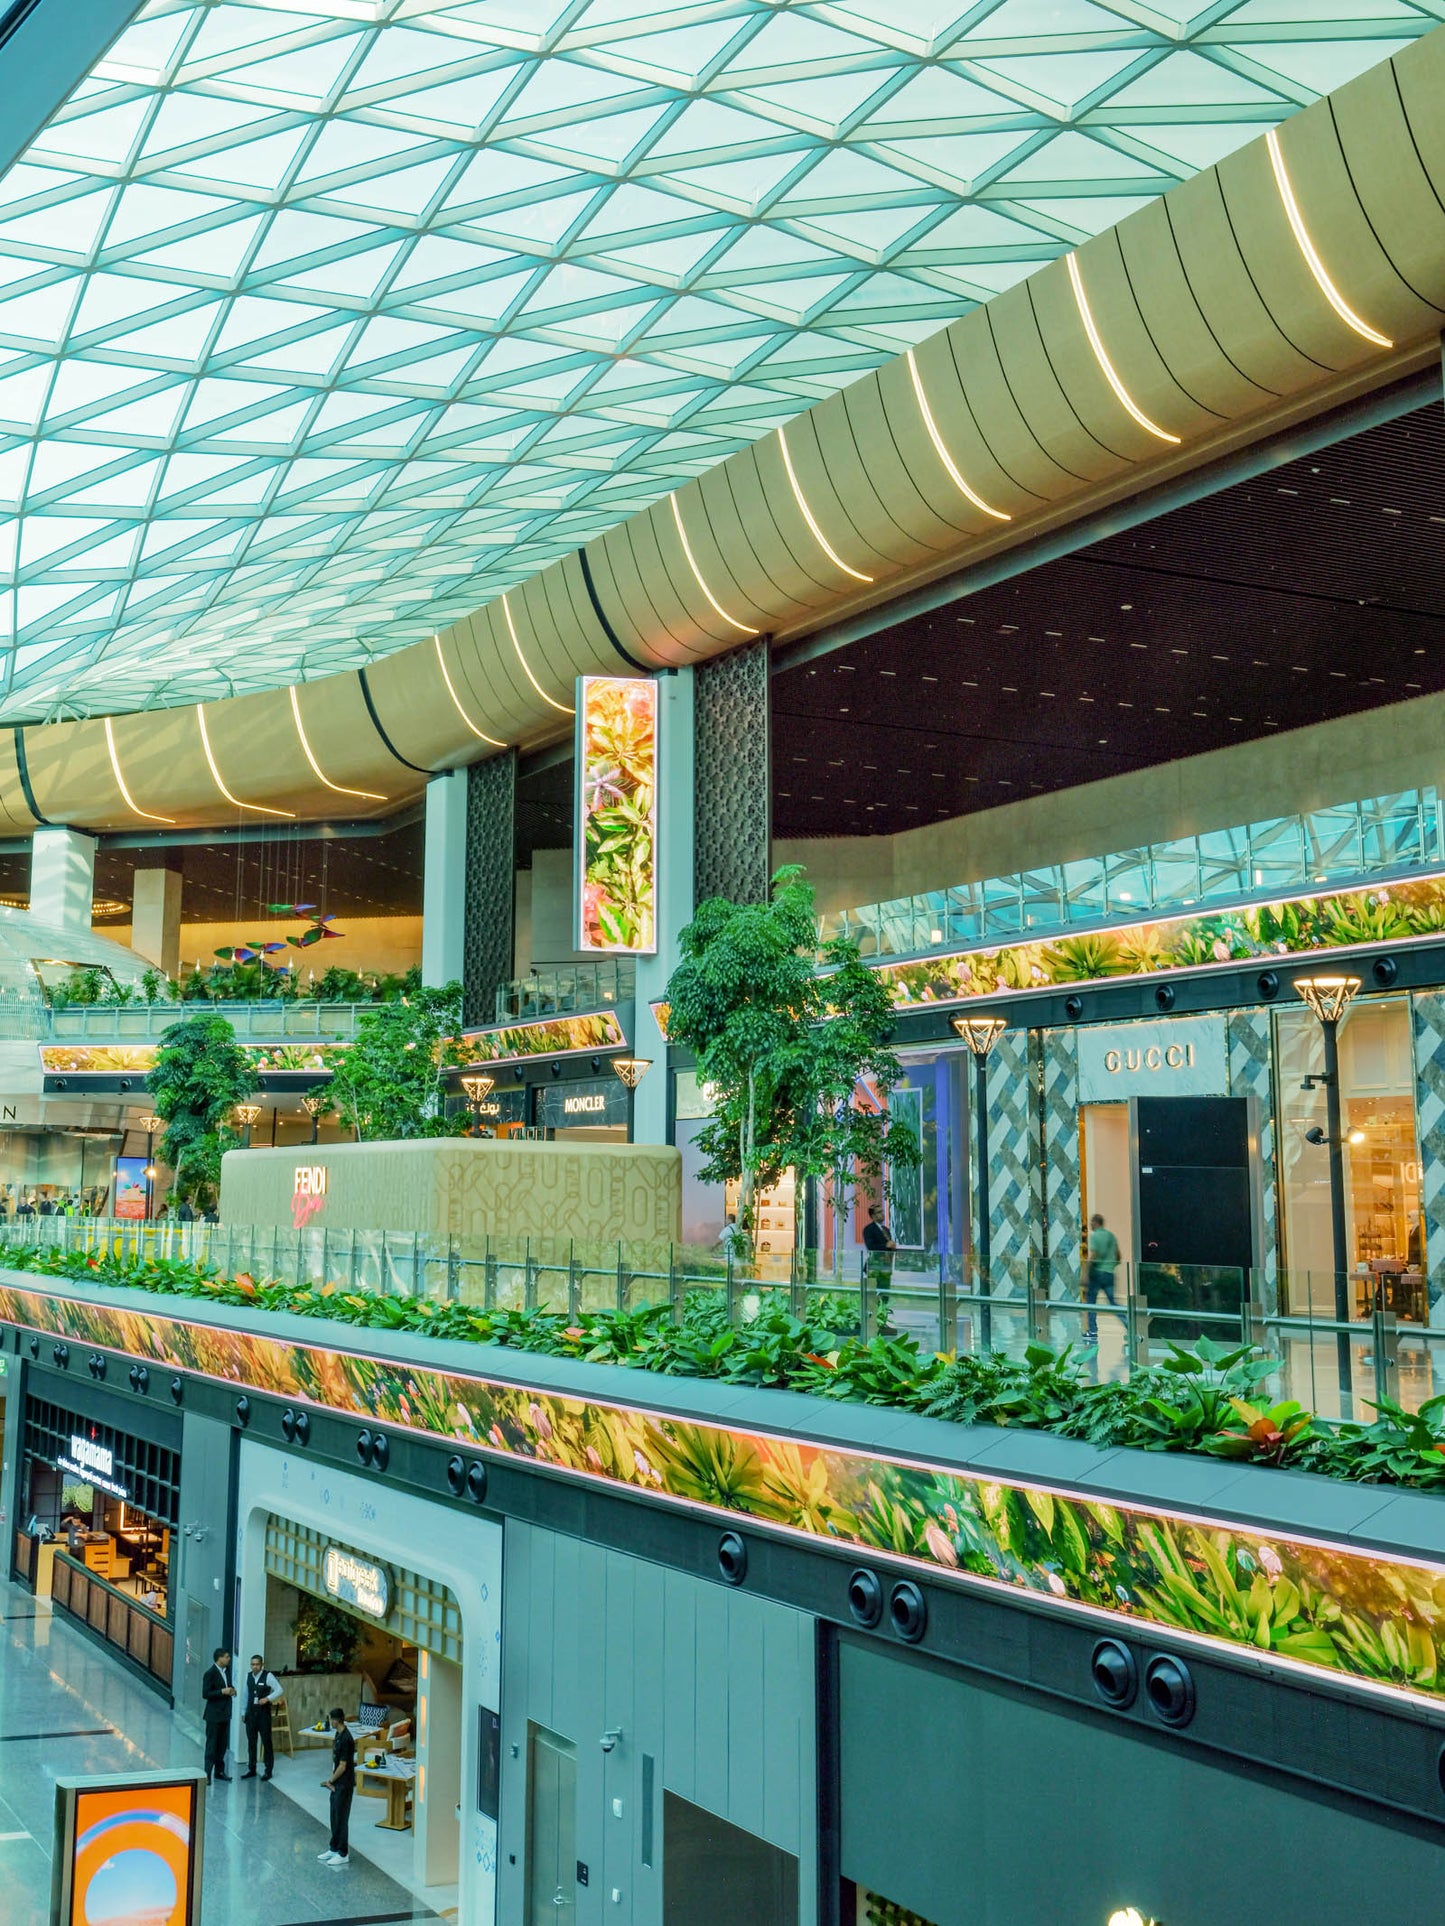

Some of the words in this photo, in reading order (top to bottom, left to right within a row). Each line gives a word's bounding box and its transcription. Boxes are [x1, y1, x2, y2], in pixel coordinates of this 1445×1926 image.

[1104, 1042, 1195, 1073] GUCCI
[564, 1095, 606, 1113] MONCLER
[294, 1166, 328, 1195] FENDI
